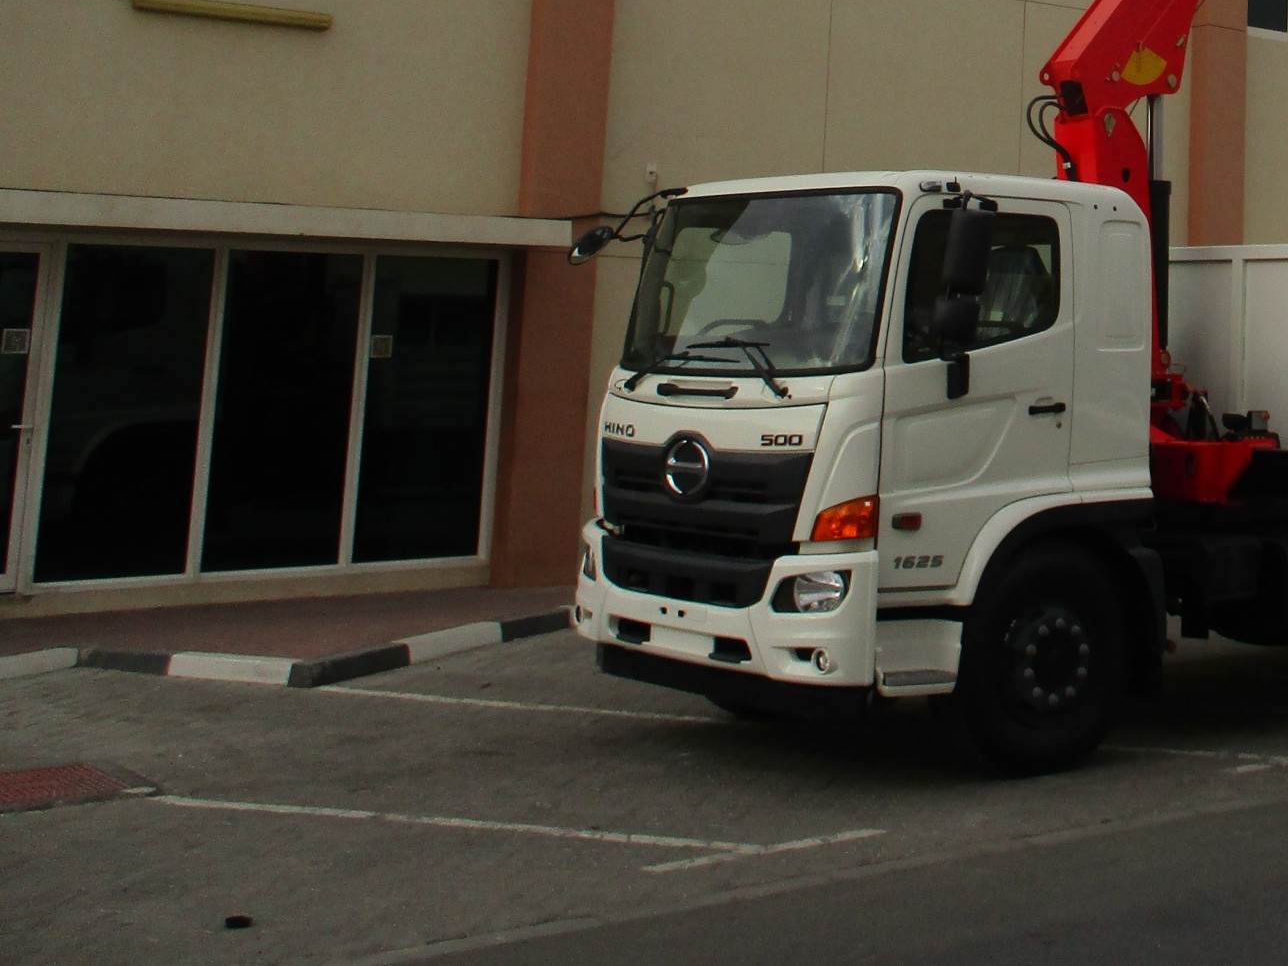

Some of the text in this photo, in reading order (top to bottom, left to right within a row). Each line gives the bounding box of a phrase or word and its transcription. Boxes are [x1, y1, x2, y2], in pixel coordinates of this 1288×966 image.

[604, 420, 635, 437] HINO
[760, 434, 804, 447] 500
[893, 554, 944, 570] 1625
